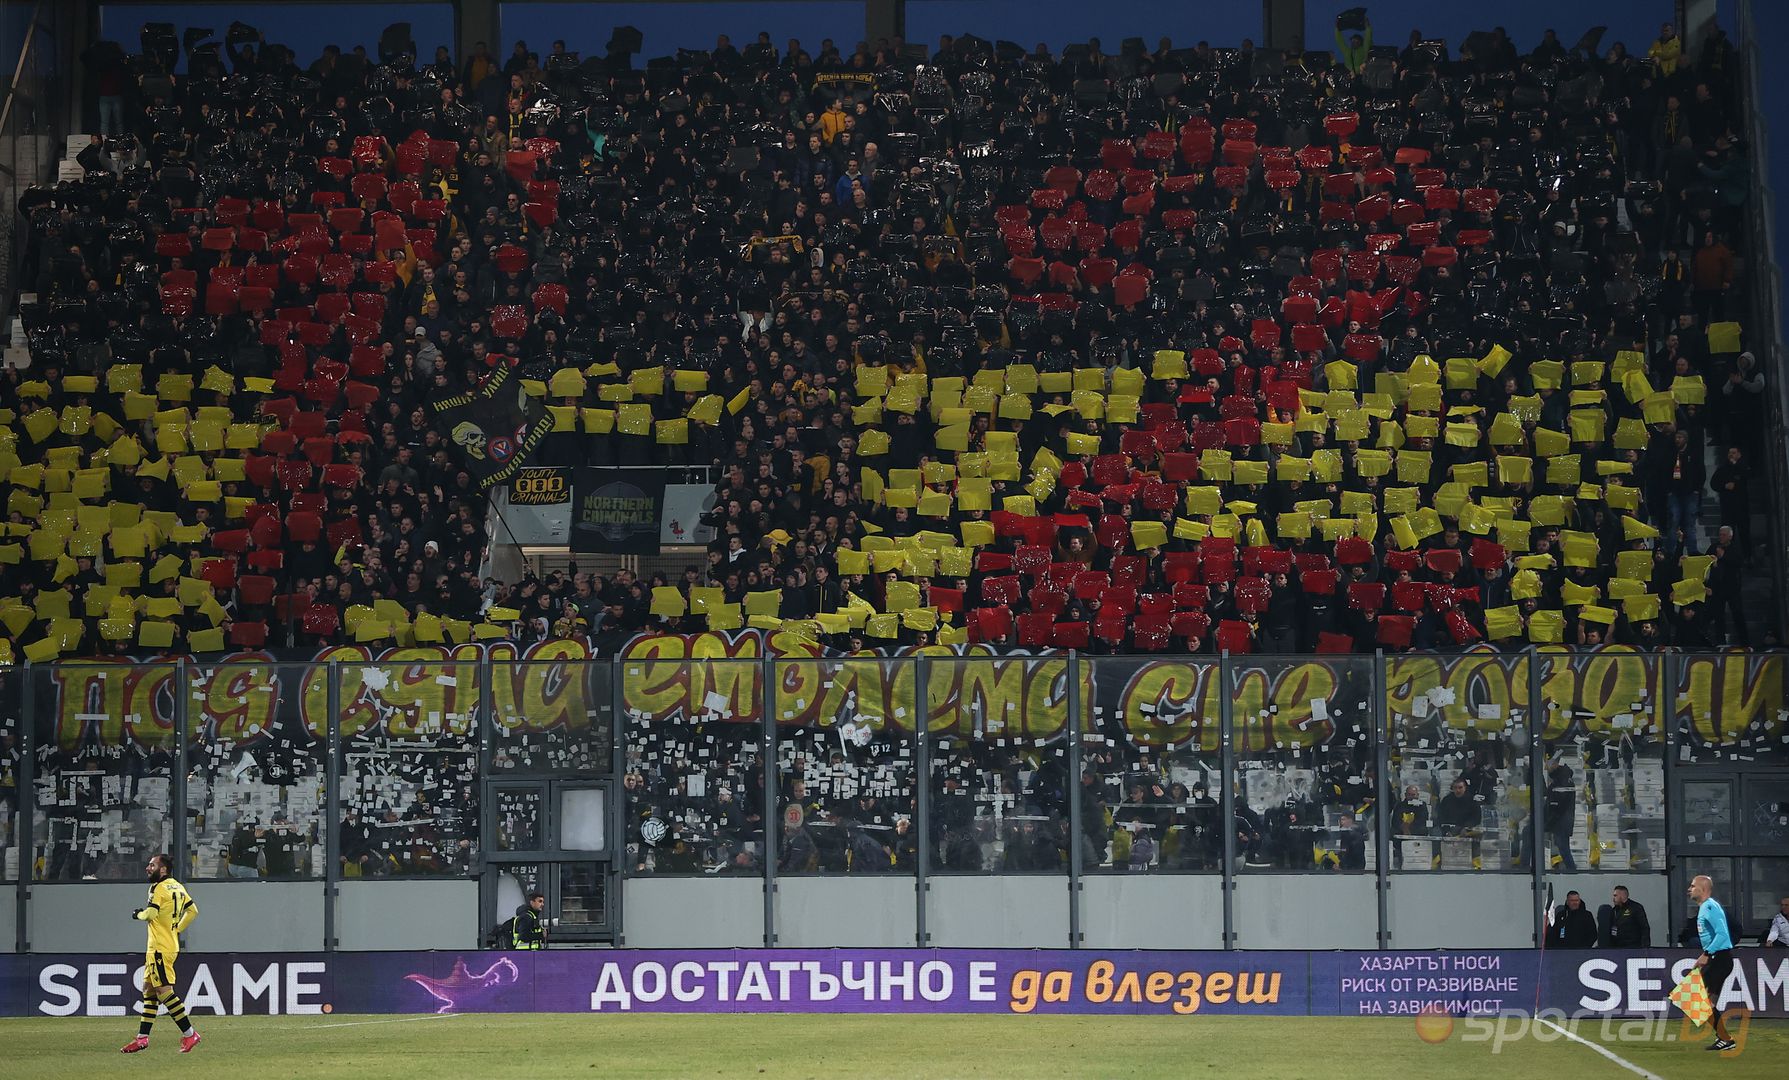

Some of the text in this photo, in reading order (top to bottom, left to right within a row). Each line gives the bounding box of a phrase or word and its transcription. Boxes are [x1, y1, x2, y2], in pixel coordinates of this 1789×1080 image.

[523, 414, 555, 452] ГРАД!
[520, 469, 557, 479] YOUTH
[510, 490, 568, 504] CRIMINALS
[583, 495, 655, 511] NORTHERN
[582, 510, 654, 525] CRIMINALS
[1360, 956, 1500, 971] ХАЗАРТЪТ НОСИ
[591, 960, 1282, 1014] ДОСТАТЪЧНО Е да влезеш
[1341, 977, 1518, 993] РИСК ОТ РАЗВИВАНЕ
[1359, 1000, 1502, 1014] НА ЗАВИСИМОСТ
